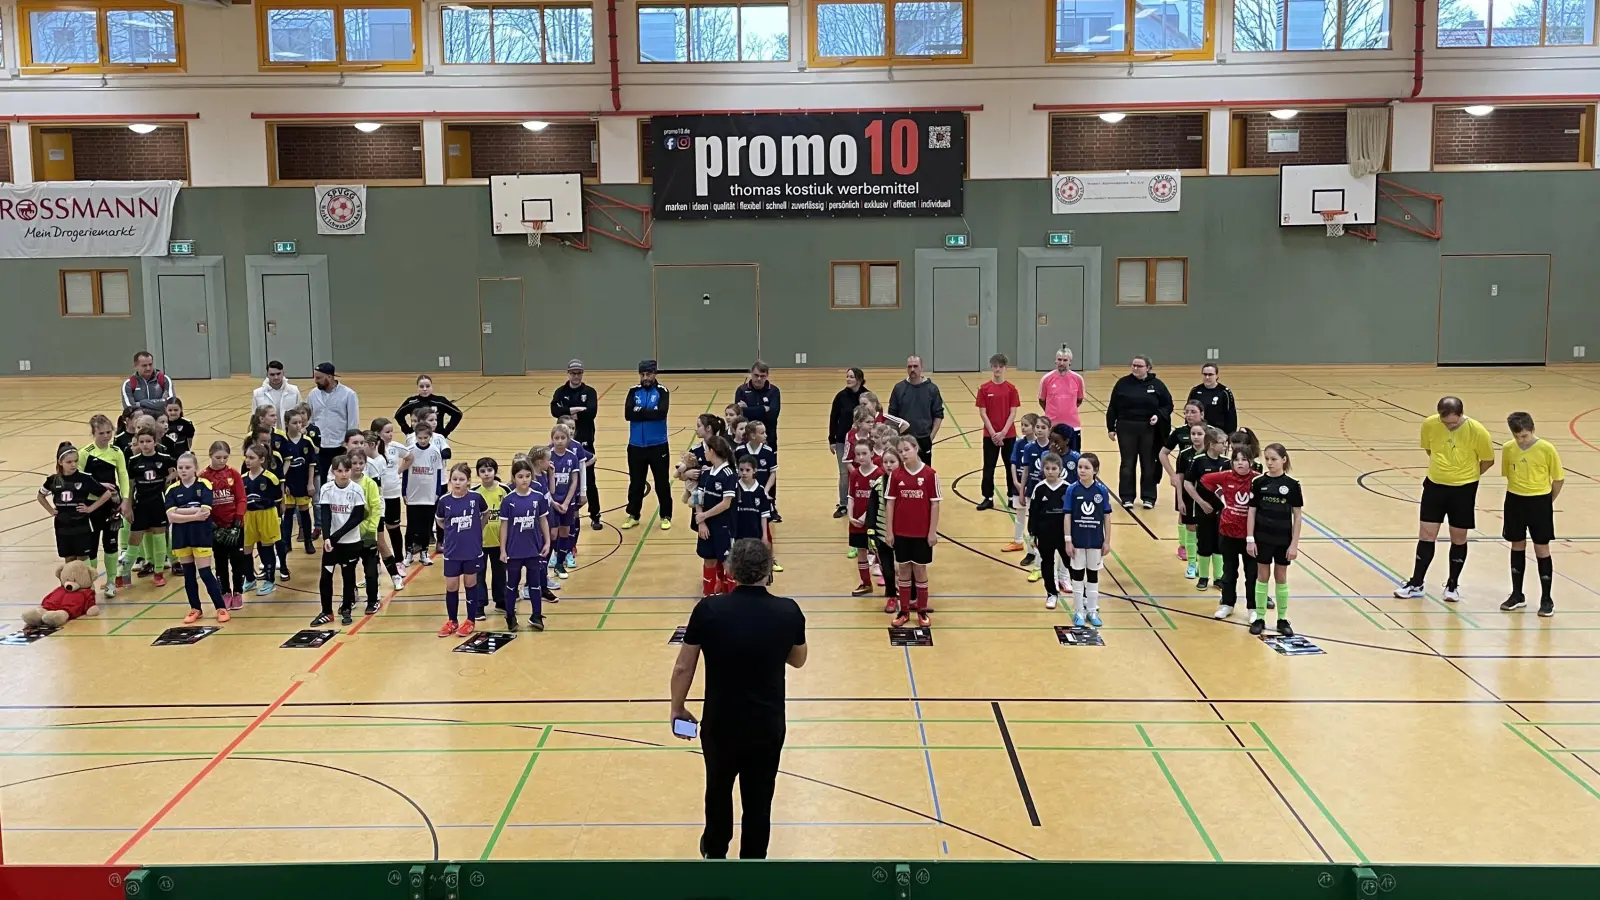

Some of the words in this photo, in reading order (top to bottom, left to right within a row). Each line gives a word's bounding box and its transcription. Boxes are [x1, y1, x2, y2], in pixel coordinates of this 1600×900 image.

[327, 188, 356, 199] SPVGG
[730, 184, 781, 196] thomas
[785, 183, 834, 196] kostiuk
[837, 182, 919, 195] werbemittel
[0, 197, 158, 221] ROSSMANN
[665, 203, 688, 211] marken
[692, 202, 709, 211] ideen
[713, 201, 736, 212] qualität
[740, 201, 761, 210] flexibel
[765, 201, 787, 210] schnell
[791, 201, 825, 212] zuverlässig
[828, 200, 860, 211] persönlich
[863, 199, 889, 209] exklusiv
[892, 199, 917, 209] effizient
[920, 199, 951, 209] individuell
[24, 227, 51, 238] Mein
[51, 225, 137, 242] Drogeriemarkt
[61, 491, 73, 502] TL
[212, 488, 231, 498] KMS
